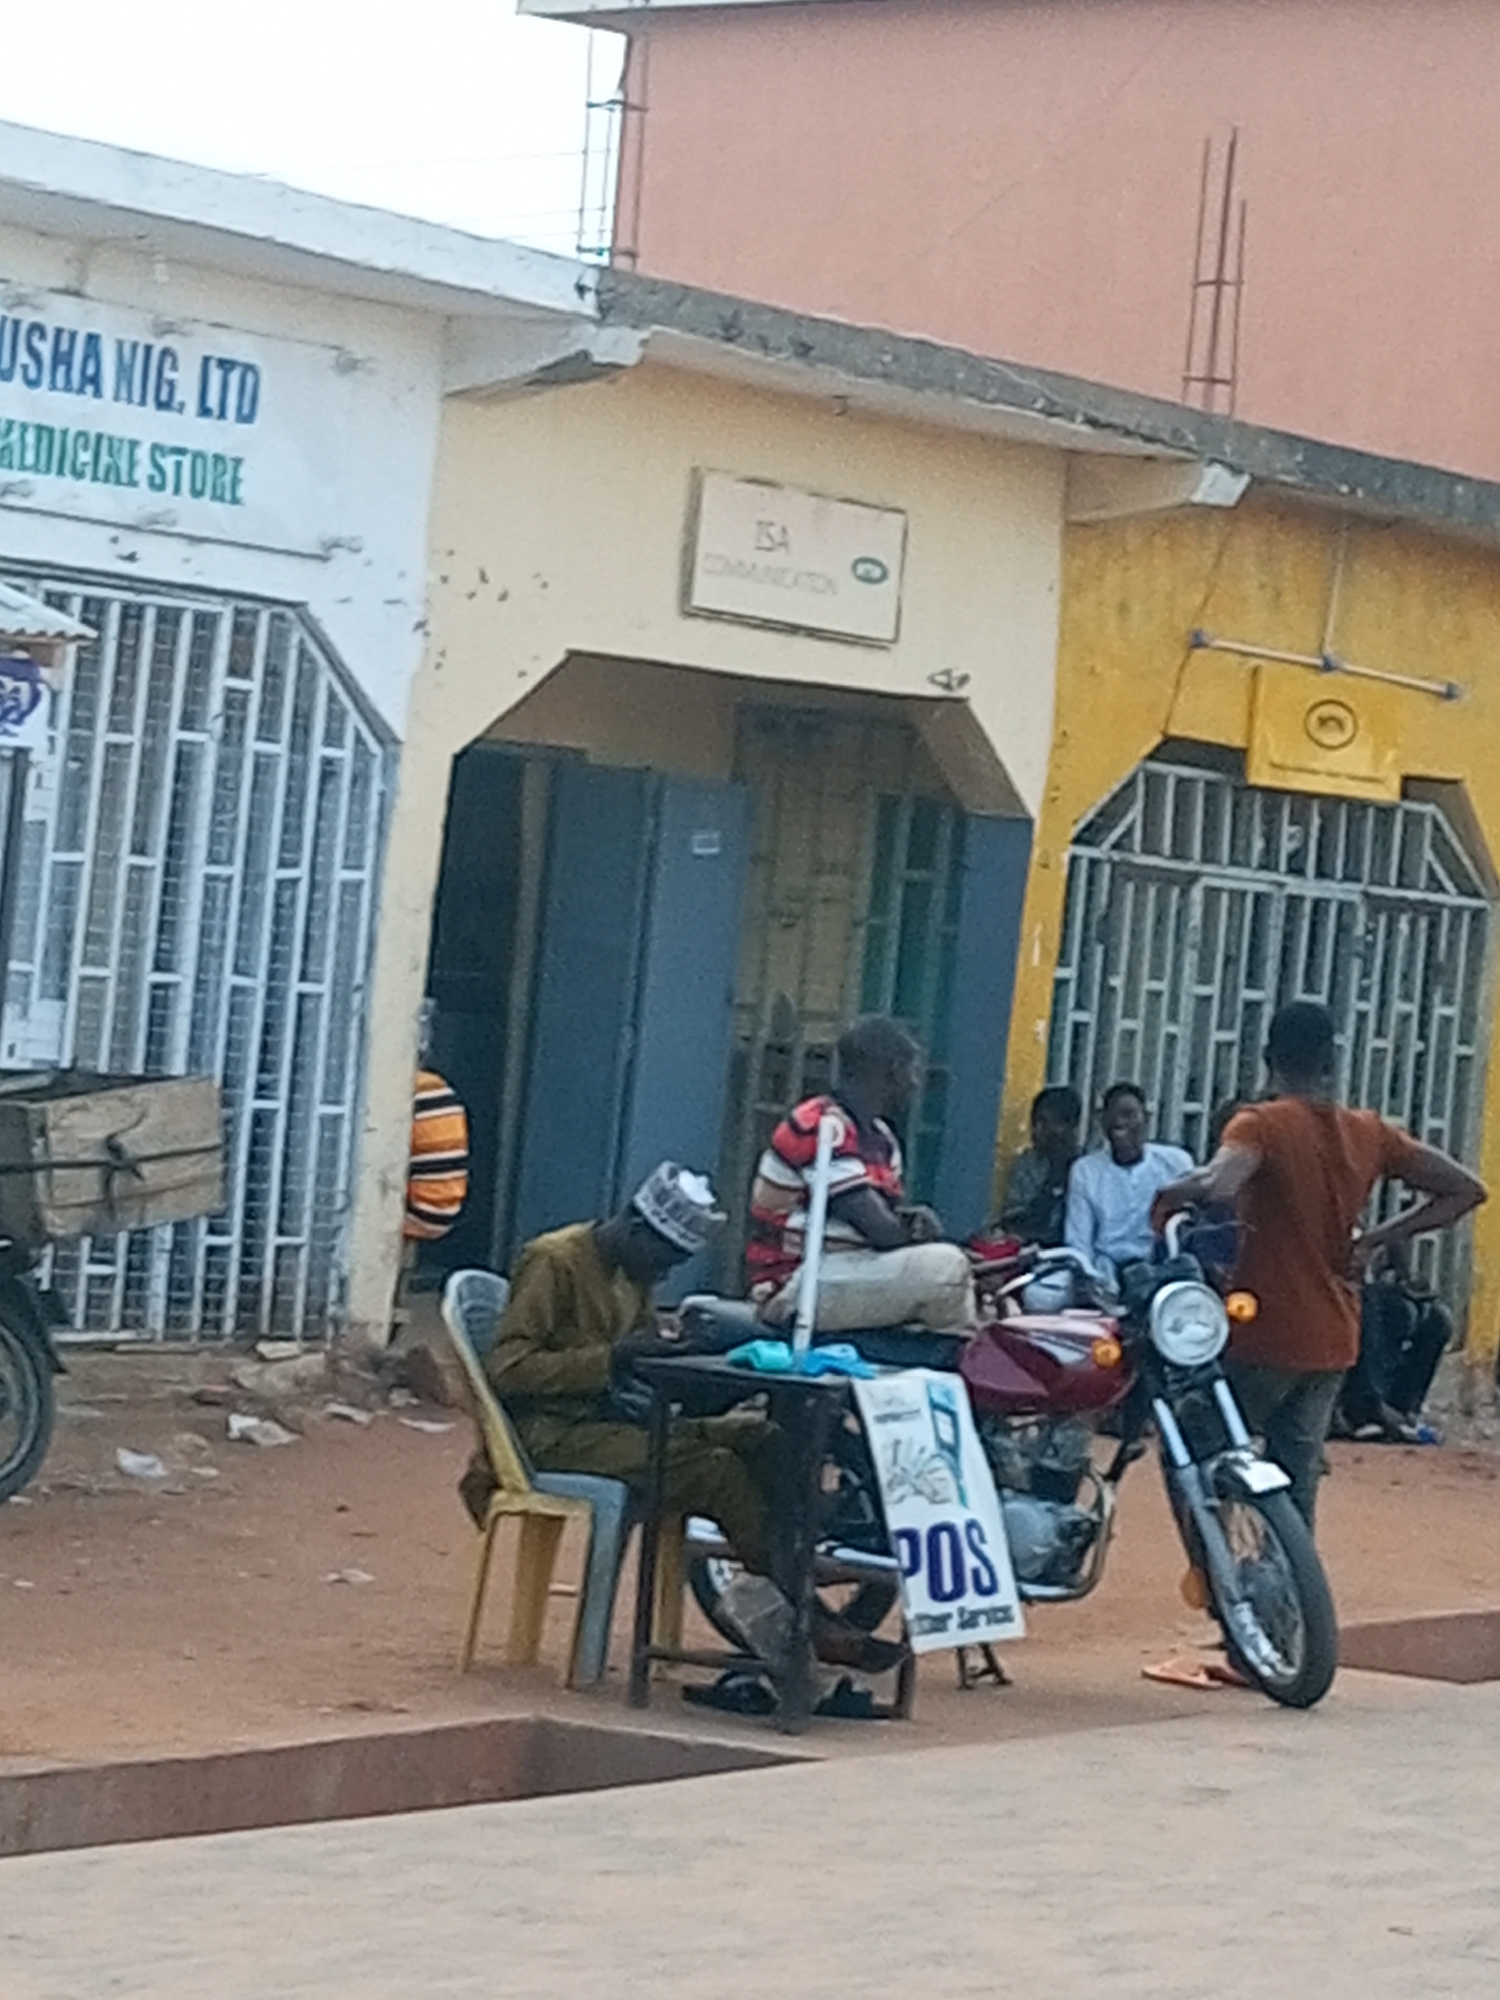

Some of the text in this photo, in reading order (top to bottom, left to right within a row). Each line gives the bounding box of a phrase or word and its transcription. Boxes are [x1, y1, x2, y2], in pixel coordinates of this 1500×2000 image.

[195, 354, 261, 425] LTD
[147, 442, 245, 506] STORE
[893, 1517, 1000, 1604] POS
